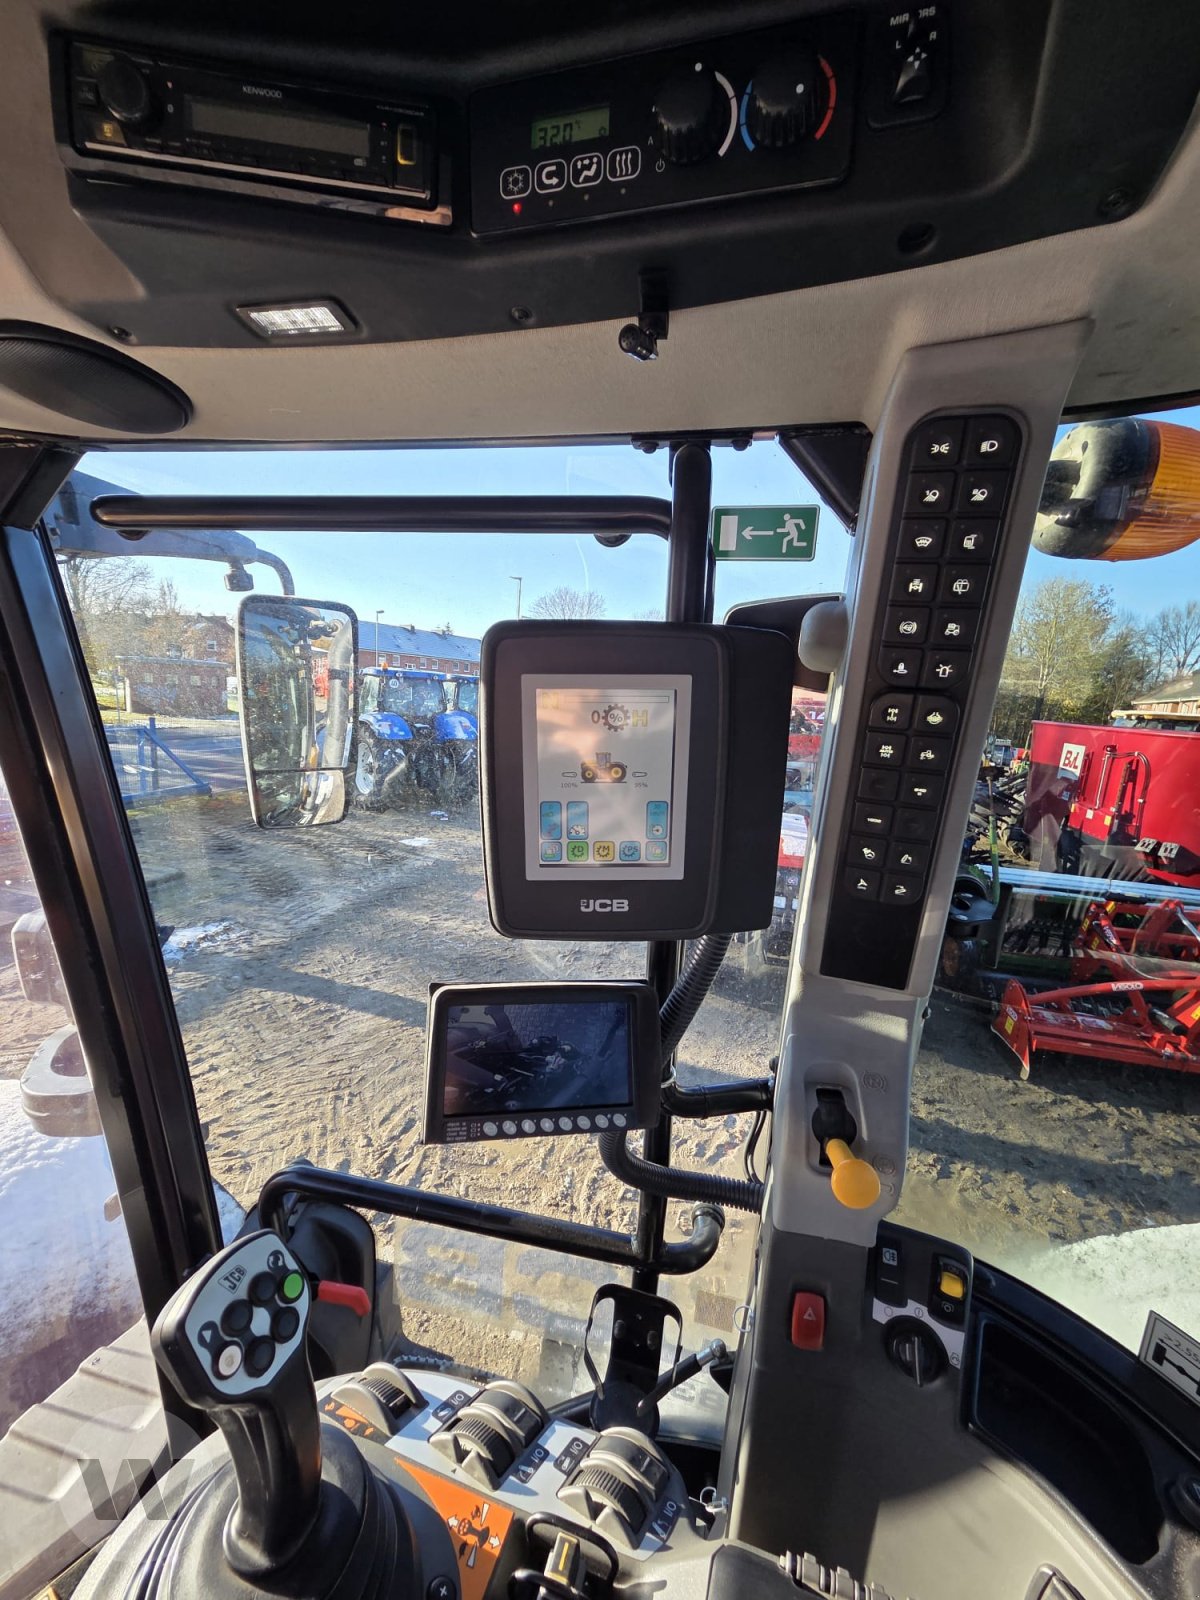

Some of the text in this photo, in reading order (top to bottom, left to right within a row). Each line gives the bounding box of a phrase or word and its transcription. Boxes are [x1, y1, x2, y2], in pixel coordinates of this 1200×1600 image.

[890, 6, 936, 27] MIRRS
[929, 31, 937, 42] R
[896, 40, 902, 50] L
[242, 85, 283, 99] KENWOOD
[632, 709, 649, 728] H
[580, 898, 630, 913] JCB
[223, 1267, 245, 1291] JCB
